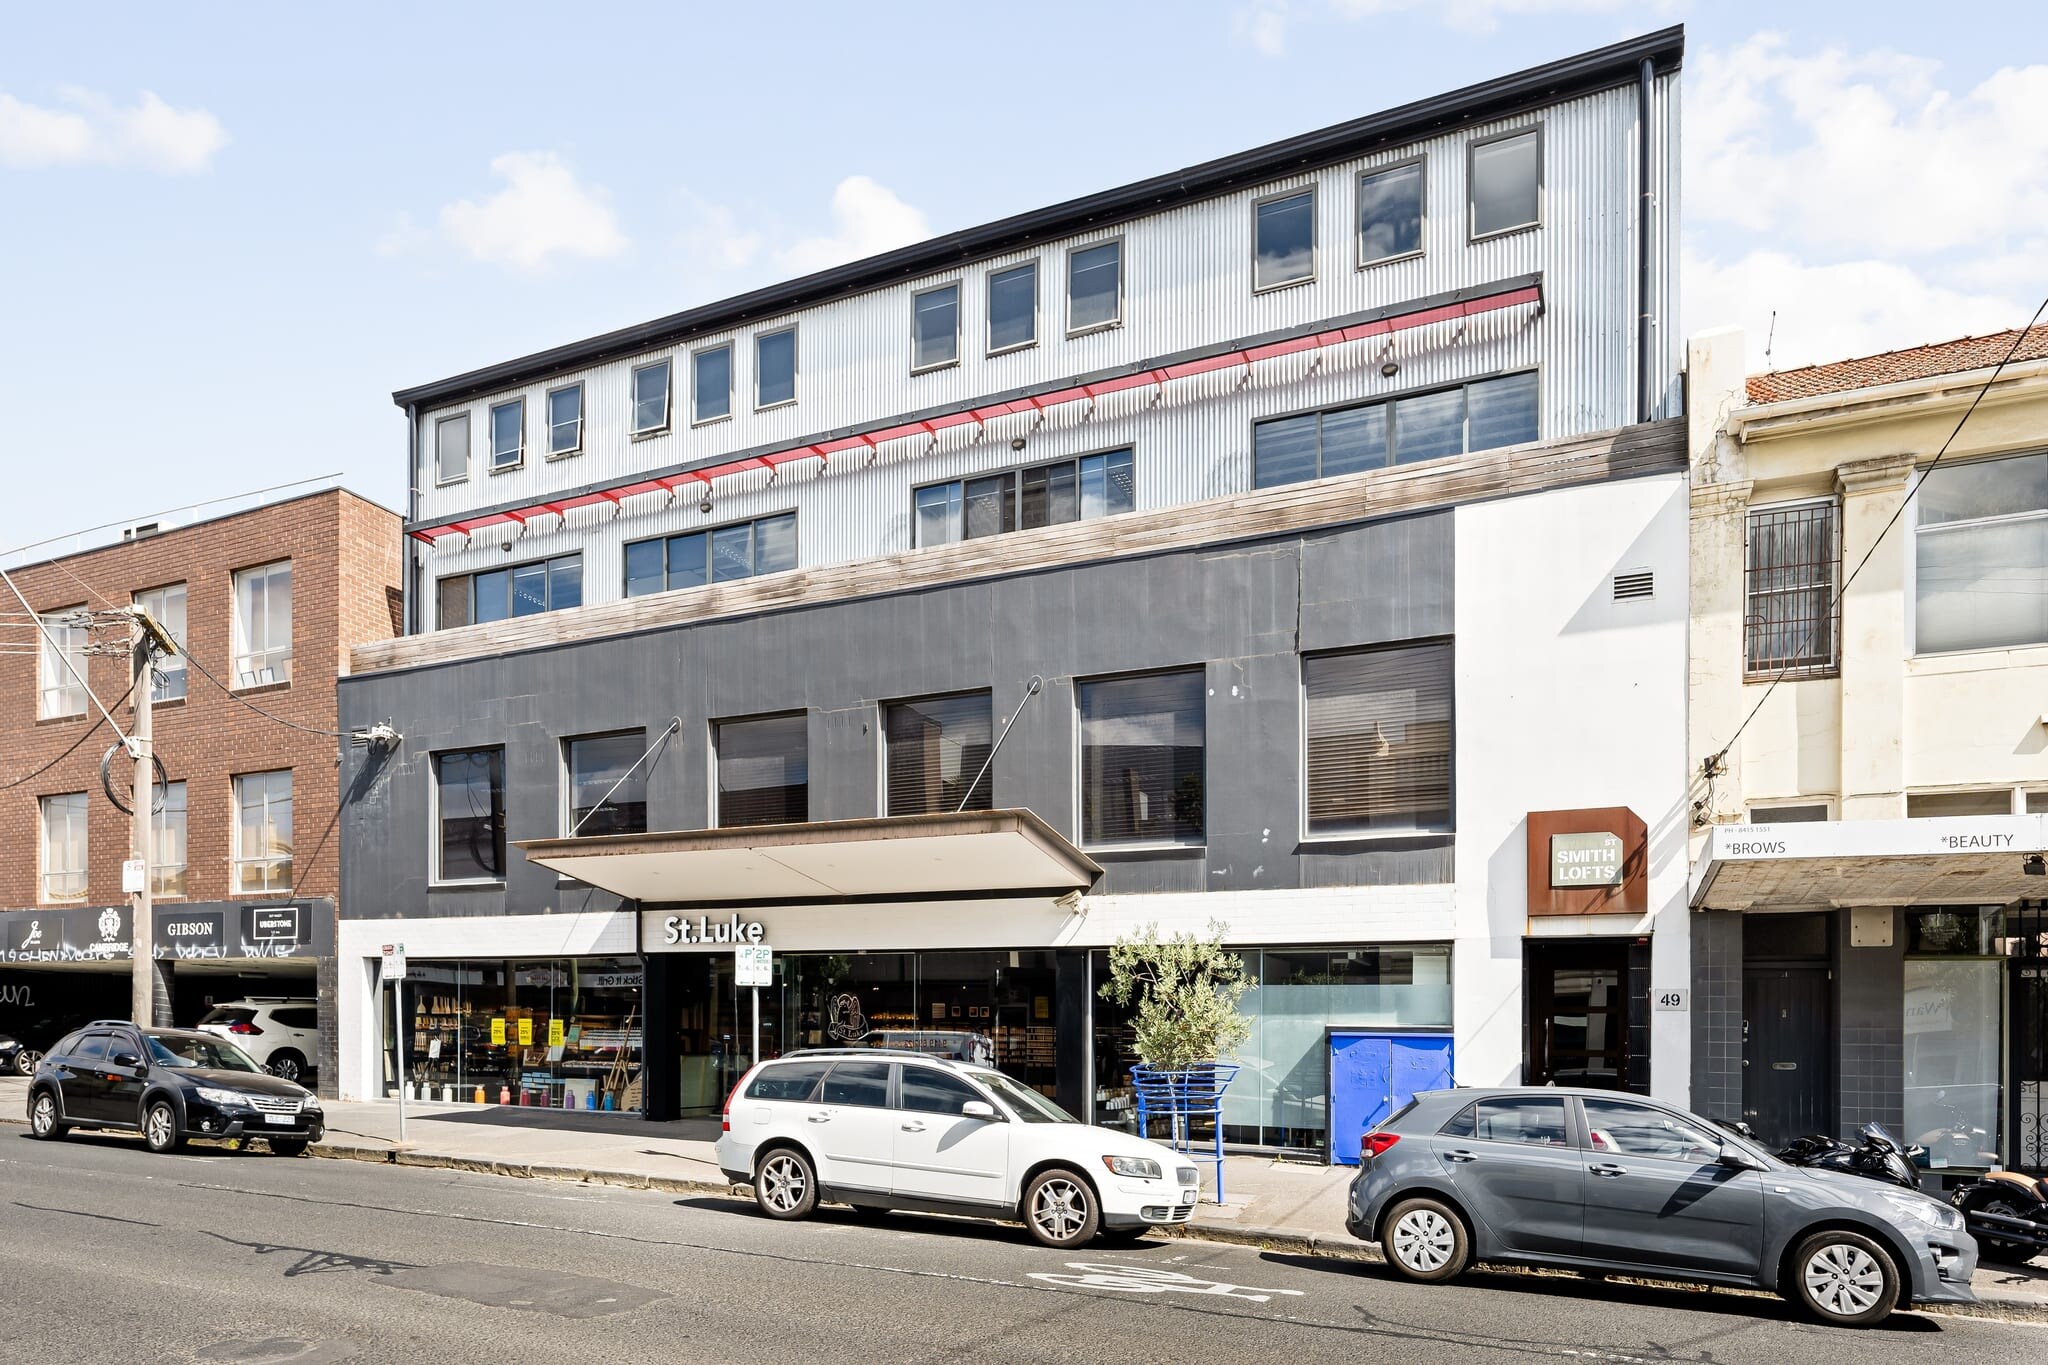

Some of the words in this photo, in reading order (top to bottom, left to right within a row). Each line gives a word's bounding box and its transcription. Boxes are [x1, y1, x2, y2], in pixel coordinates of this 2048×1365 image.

[1557, 848, 1616, 864] SMITH
[1559, 865, 1616, 880] LOFTS
[167, 922, 214, 936] GIBSON
[664, 913, 764, 944] St.Luke
[89, 942, 129, 952] CAMBRIDGE
[755, 949, 770, 959] 2P
[1660, 994, 1680, 1006] 49
